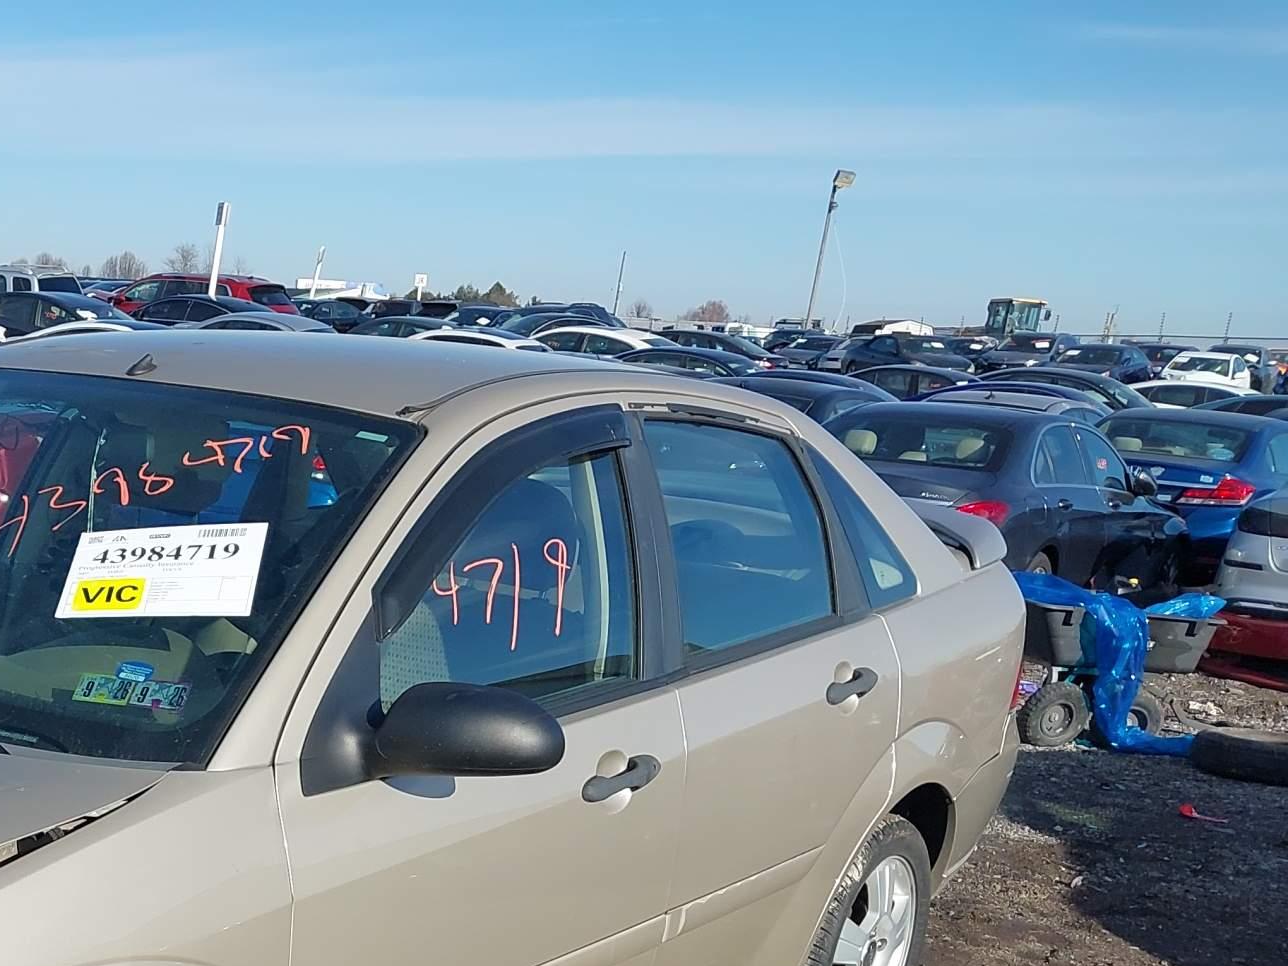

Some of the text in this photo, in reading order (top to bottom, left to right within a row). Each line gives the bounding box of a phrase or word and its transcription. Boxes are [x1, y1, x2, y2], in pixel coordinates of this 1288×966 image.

[93, 542, 241, 564] 43984719
[81, 585, 139, 603] VIC
[431, 537, 572, 651] 4719
[112, 680, 132, 699] 26
[168, 686, 188, 706] 26
